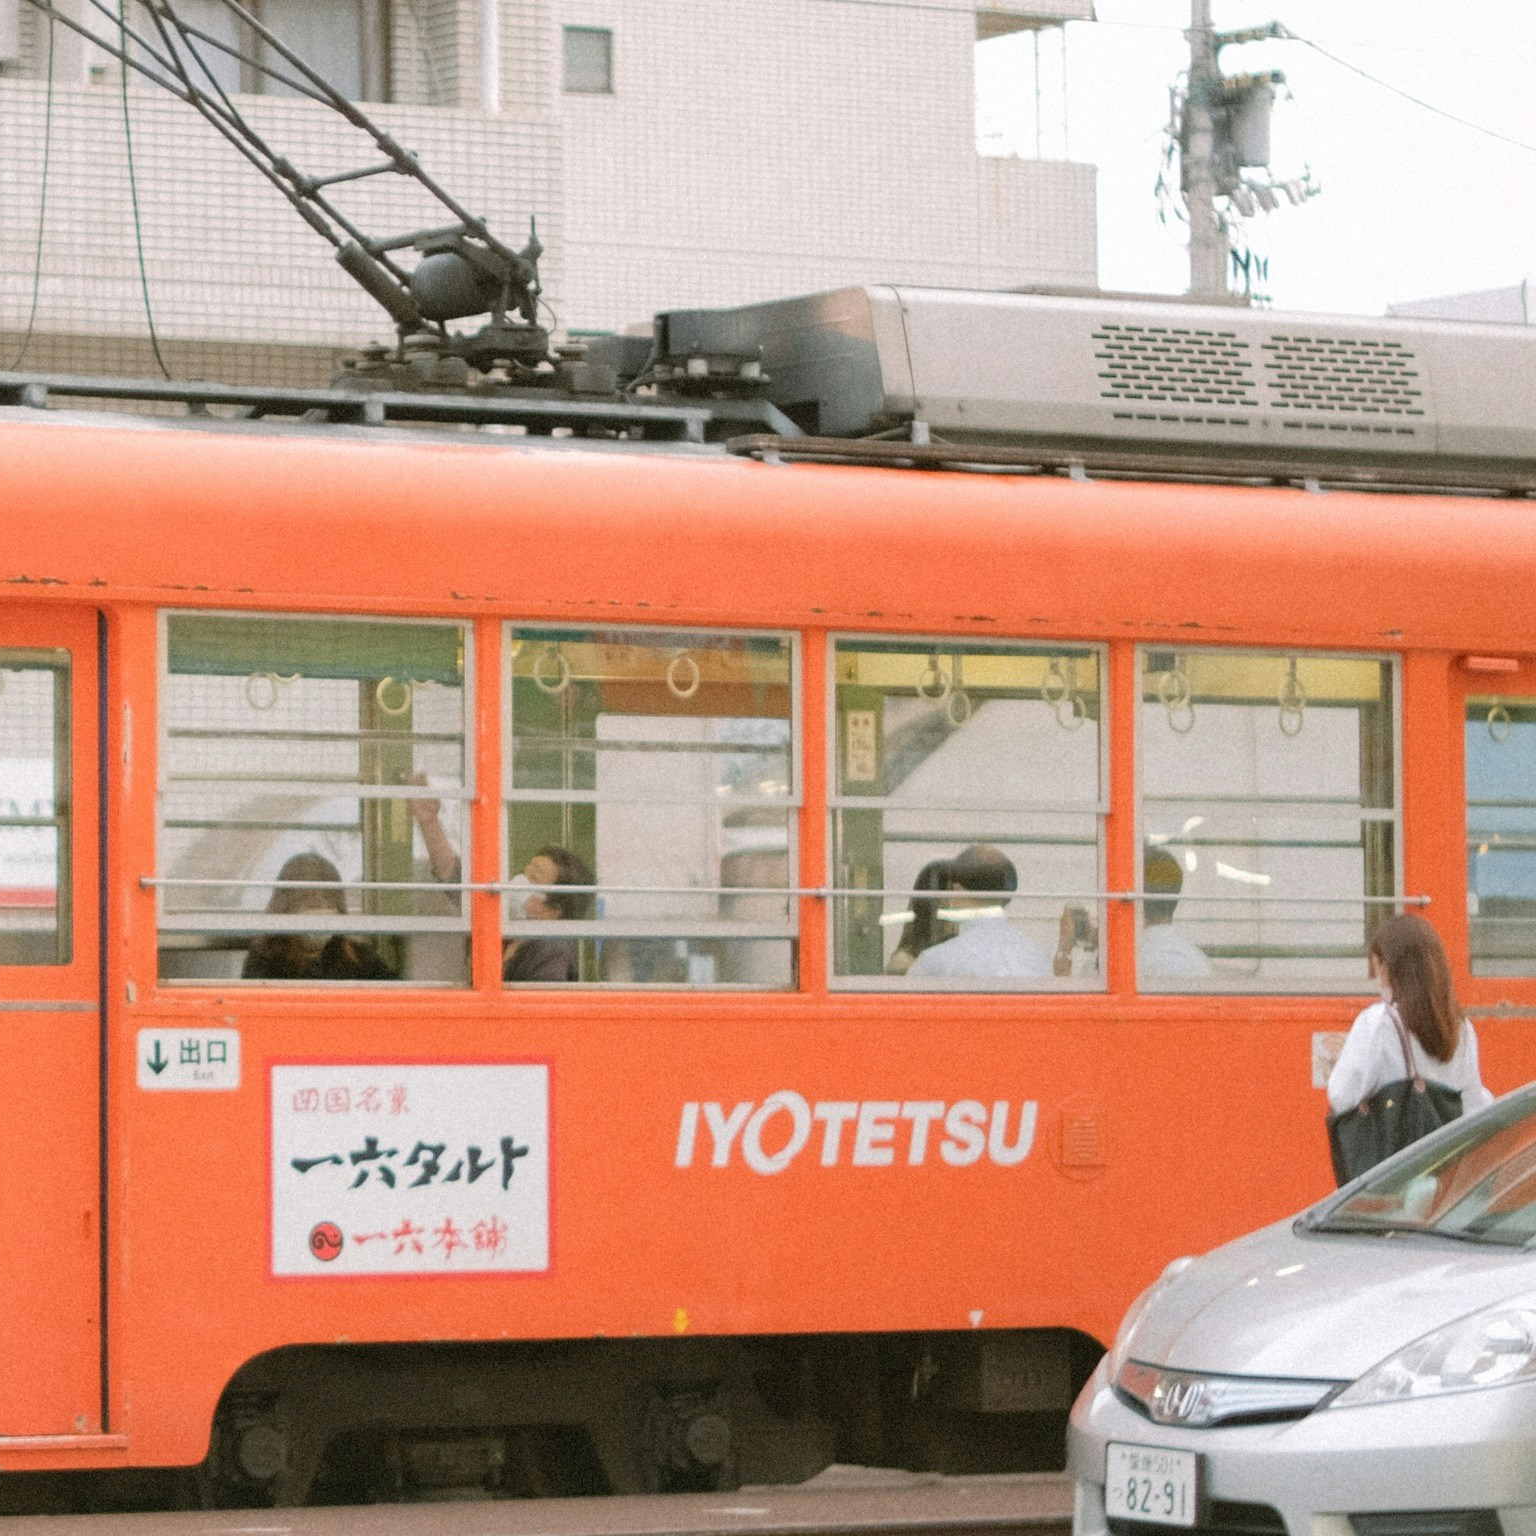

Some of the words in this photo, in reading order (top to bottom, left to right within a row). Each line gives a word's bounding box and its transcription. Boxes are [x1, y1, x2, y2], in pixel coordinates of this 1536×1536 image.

[179, 1038, 227, 1065] 出口
[673, 1090, 1039, 1176] IYOTETSU
[290, 1135, 530, 1191] 一六タルト
